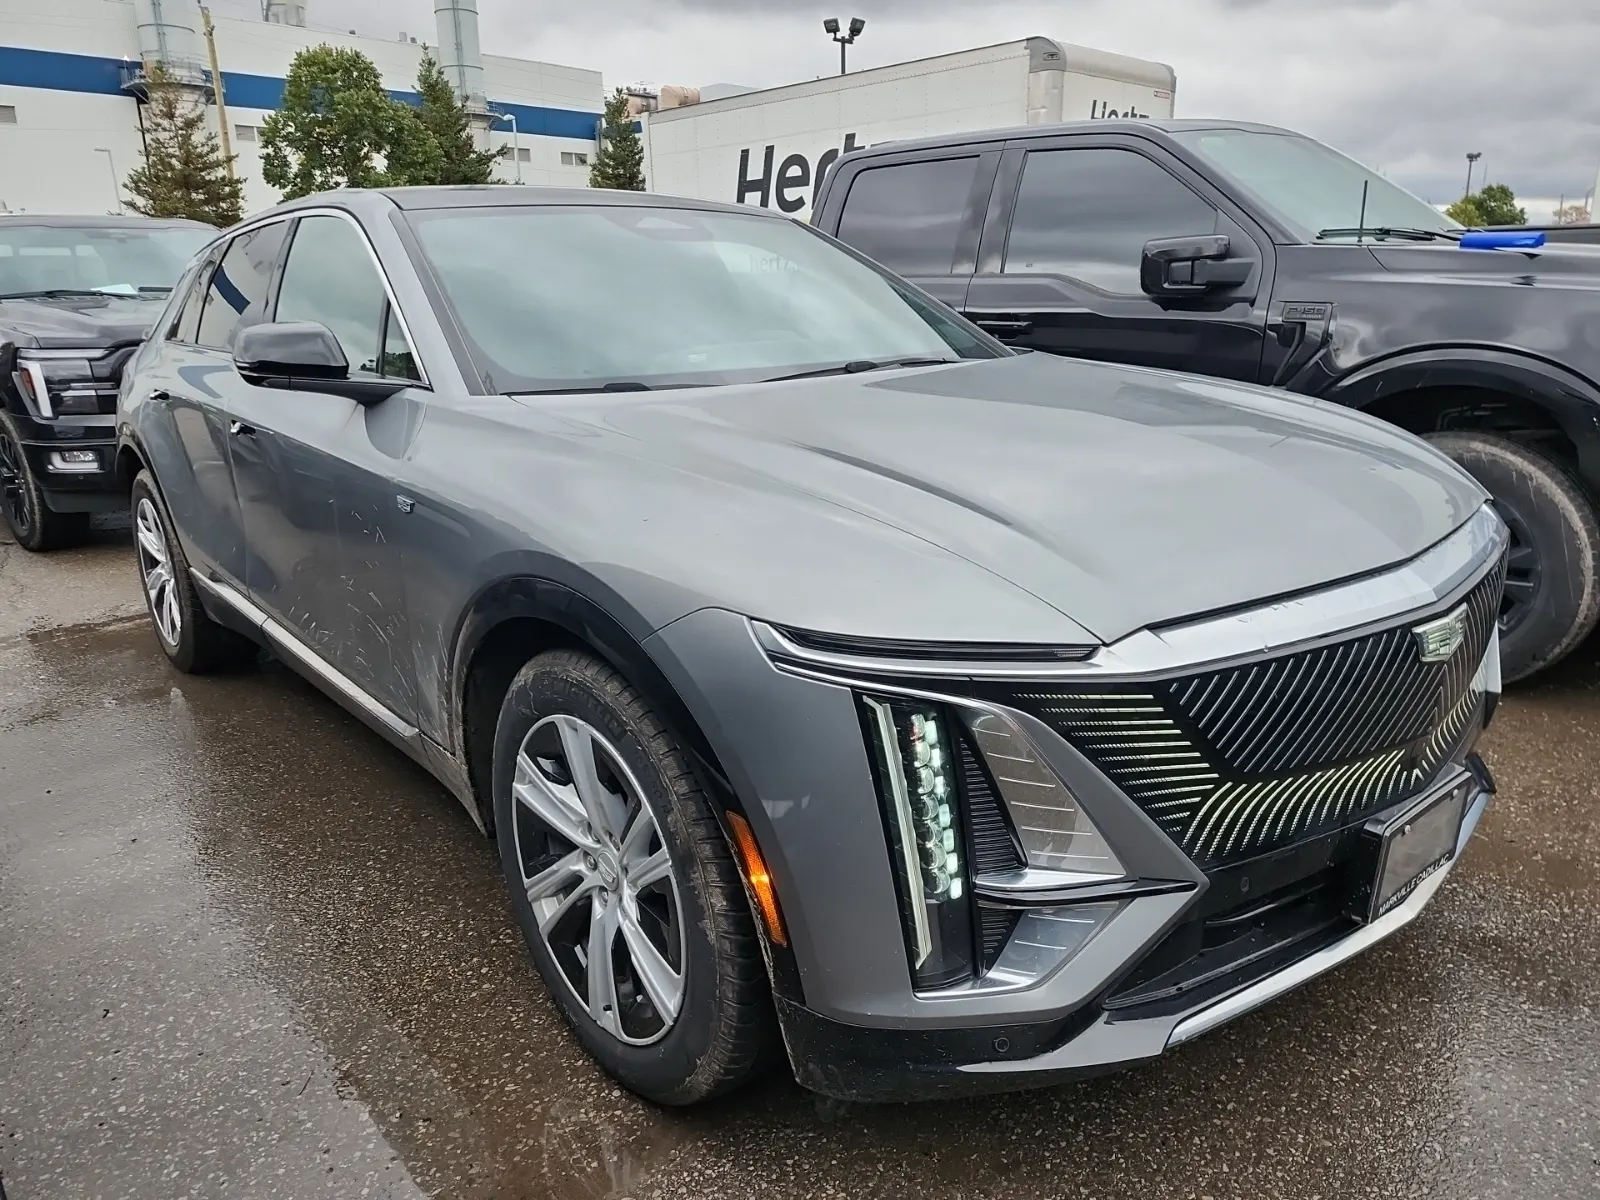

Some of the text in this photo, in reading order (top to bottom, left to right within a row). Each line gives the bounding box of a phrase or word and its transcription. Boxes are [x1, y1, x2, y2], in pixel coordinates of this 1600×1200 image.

[736, 132, 888, 213] Her
[1378, 853, 1450, 916] MARKVILLE CADILLAC
